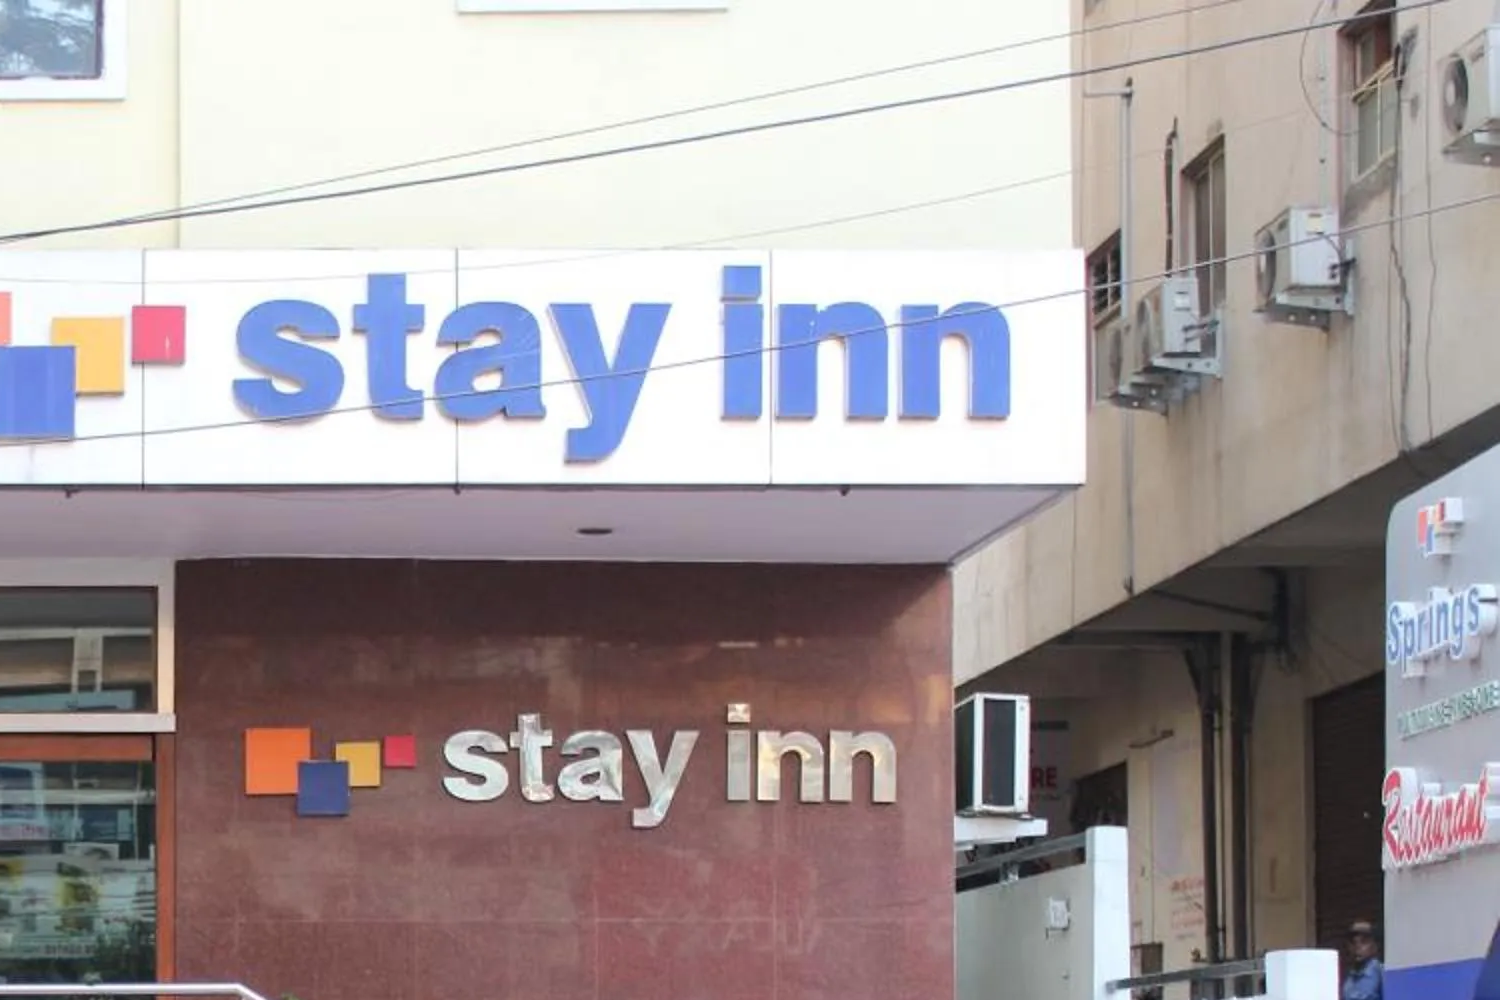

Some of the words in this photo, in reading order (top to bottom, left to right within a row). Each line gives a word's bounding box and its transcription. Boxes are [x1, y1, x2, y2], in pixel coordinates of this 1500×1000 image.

[232, 272, 673, 464] stay
[721, 264, 1013, 420] inn
[1387, 585, 1480, 673] Springs
[442, 713, 700, 828] stay
[727, 703, 898, 804] inn
